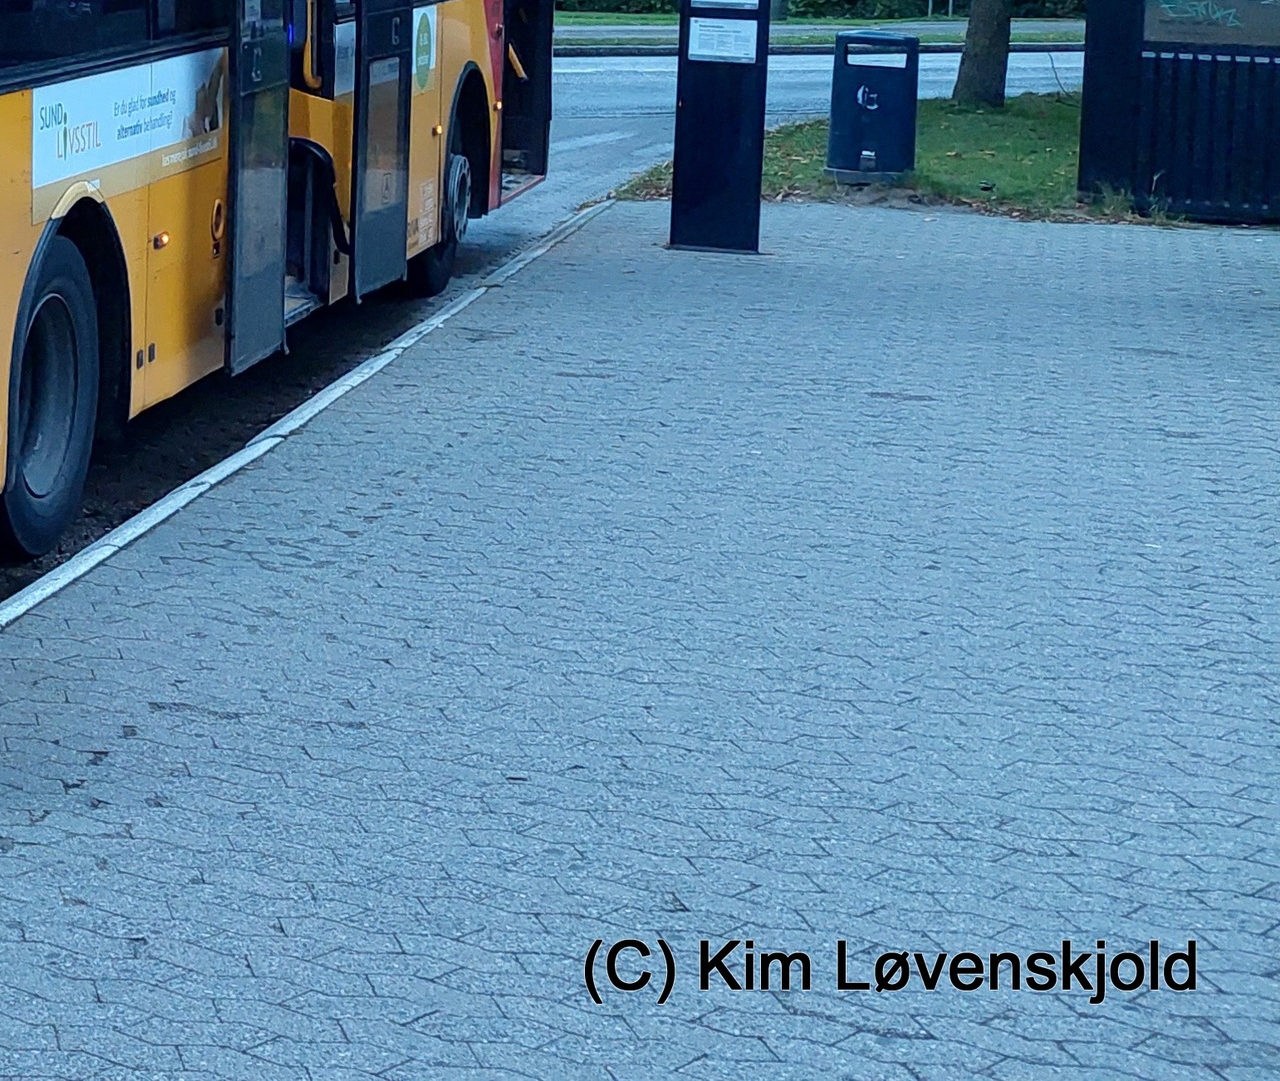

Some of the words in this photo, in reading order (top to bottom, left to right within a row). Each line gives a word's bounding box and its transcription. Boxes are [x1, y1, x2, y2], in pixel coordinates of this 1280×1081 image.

[147, 88, 170, 108] sundhed
[40, 103, 64, 131] SUND
[117, 119, 142, 140] alternativ
